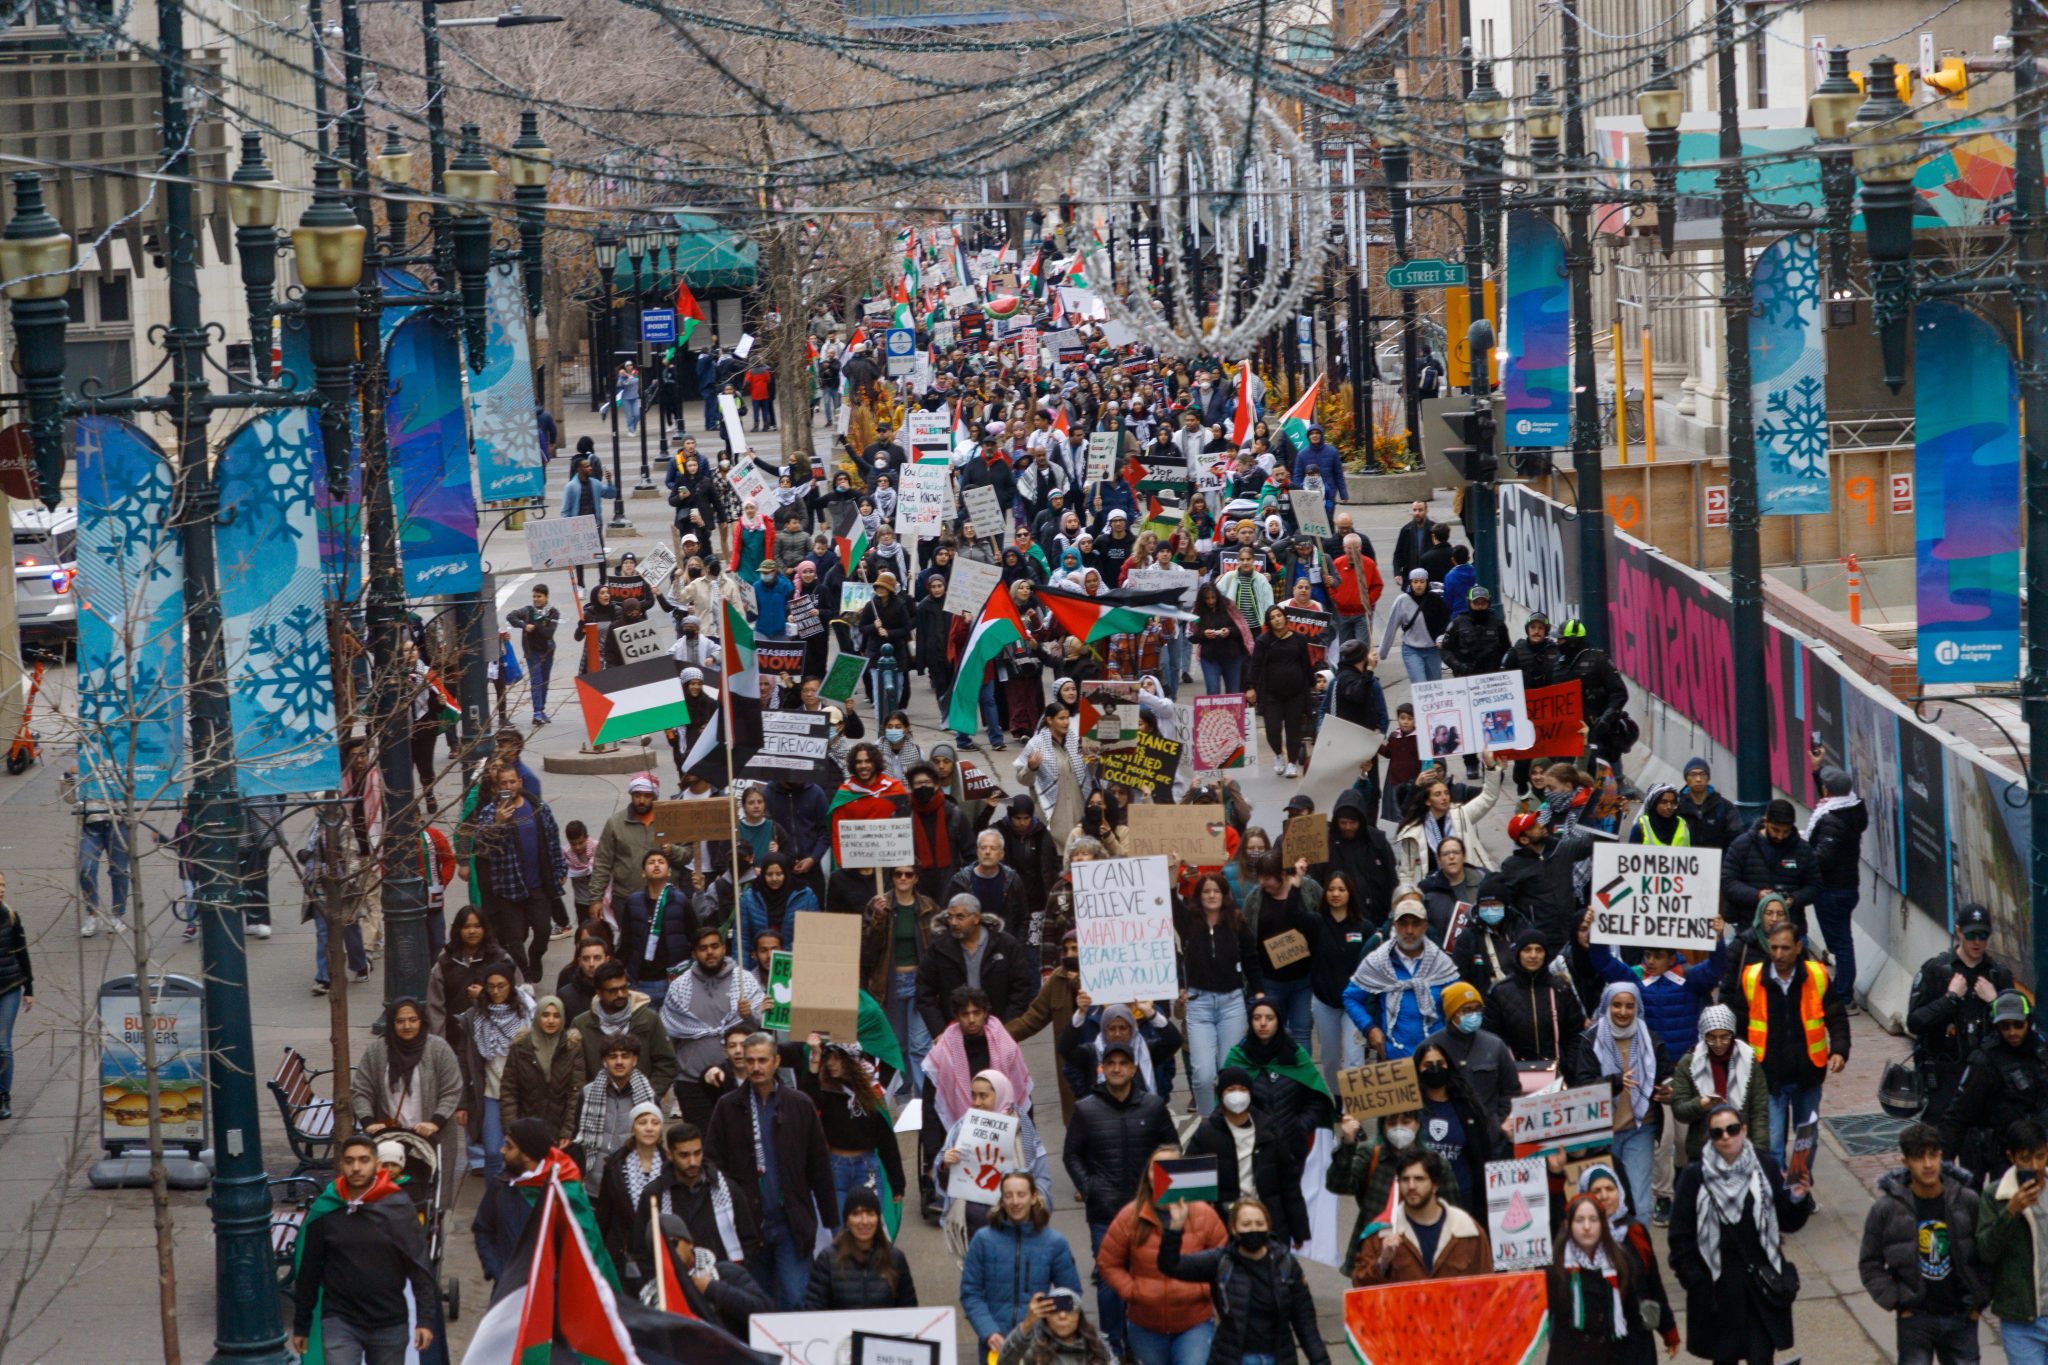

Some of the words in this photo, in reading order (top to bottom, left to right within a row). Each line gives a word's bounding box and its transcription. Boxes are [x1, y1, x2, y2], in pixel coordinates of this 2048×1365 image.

[1397, 272, 1403, 283] 1
[1407, 270, 1440, 283] STREET
[1444, 269, 1456, 281] SE
[1846, 476, 1875, 527] 9
[1304, 523, 1327, 535] RISE
[620, 626, 656, 643] GAZA
[625, 641, 660, 658] GAZA
[756, 648, 803, 656] CEASEFIRE
[1960, 652, 1991, 661] calgary
[1961, 643, 2002, 651] downtown
[1125, 764, 1156, 780] people
[1155, 773, 1173, 785] are
[1618, 855, 1699, 876] BOMBING
[1073, 865, 1088, 893] I
[1642, 876, 1684, 895] KIDS
[1074, 890, 1147, 919] BELIEVE
[1633, 896, 1649, 913] IS
[1658, 896, 1692, 914] NOT
[1077, 921, 1117, 945] WHAT
[1598, 914, 1640, 936] SELF
[1644, 916, 1717, 940] DEFENSE
[1143, 941, 1171, 961] SEE
[1080, 966, 1126, 992] WHAT
[1347, 1061, 1407, 1092] FREE
[1344, 1083, 1418, 1114] PALESTINE
[970, 1115, 979, 1125] THE
[980, 1117, 1008, 1132] GENOCIDE
[973, 1128, 988, 1139] GOES
[989, 1133, 999, 1142] ON
